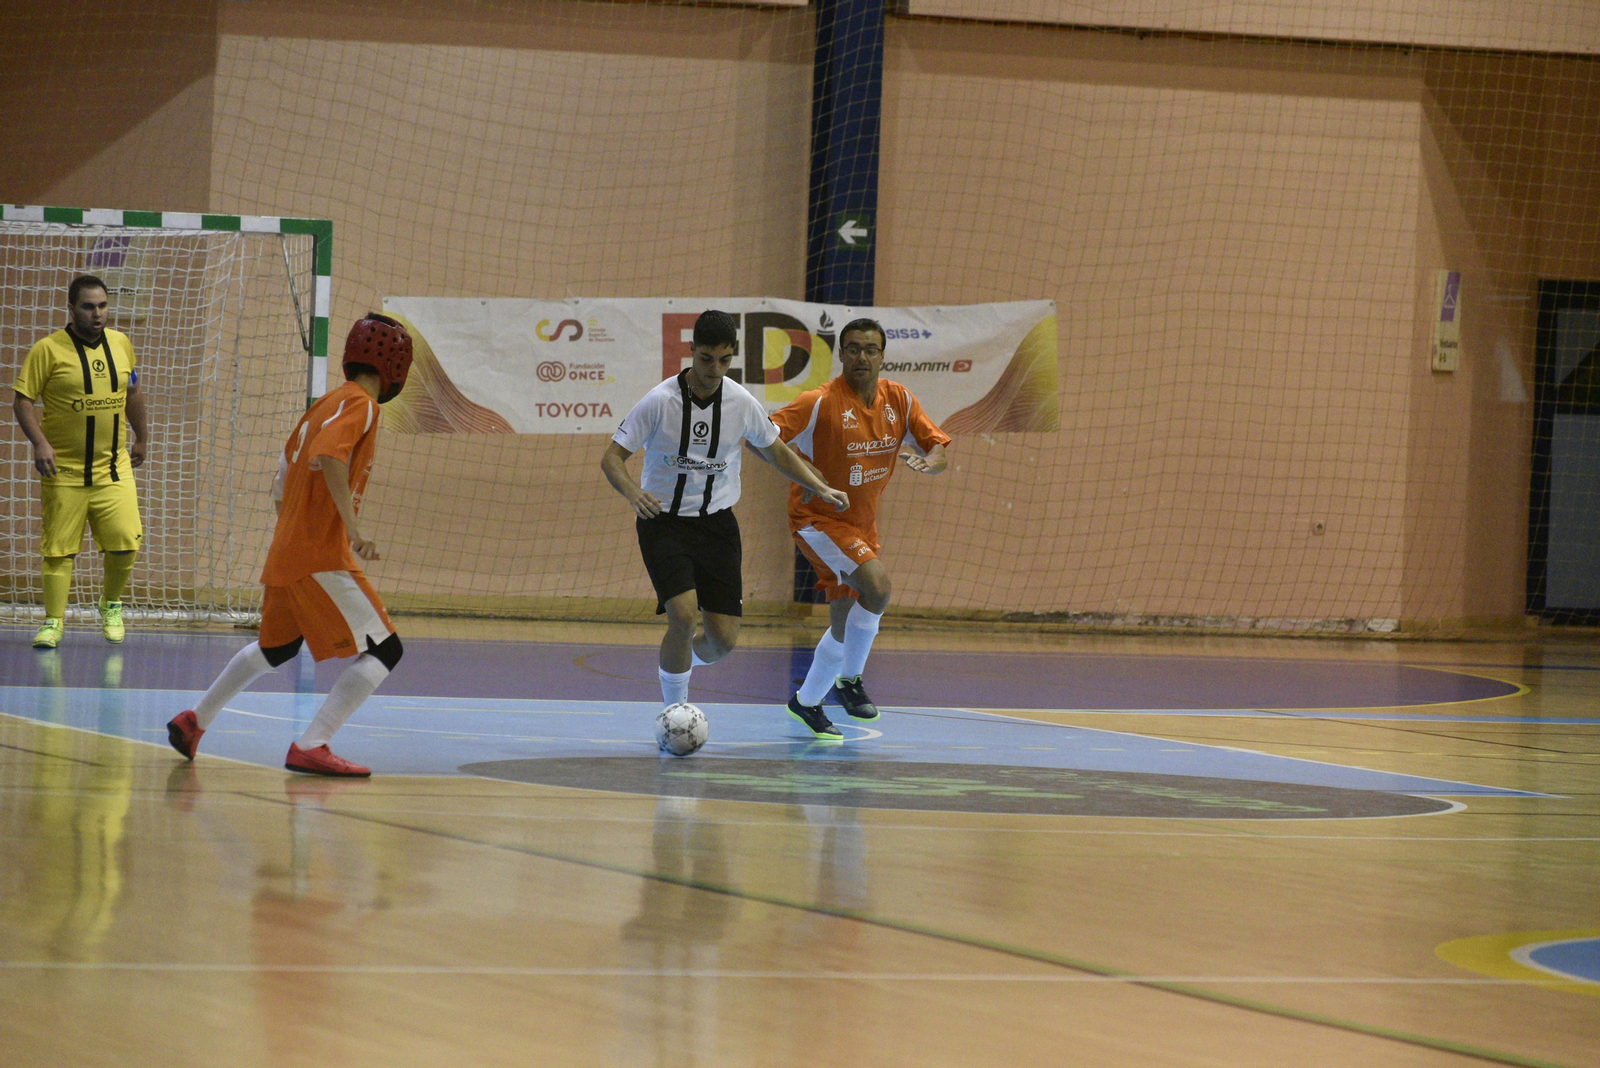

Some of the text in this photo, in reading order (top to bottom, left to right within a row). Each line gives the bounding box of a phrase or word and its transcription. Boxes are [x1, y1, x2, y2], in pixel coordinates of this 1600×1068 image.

[569, 371, 605, 380] ONCE
[535, 402, 613, 418] TOYOTA
[864, 467, 888, 476] Gobierno
